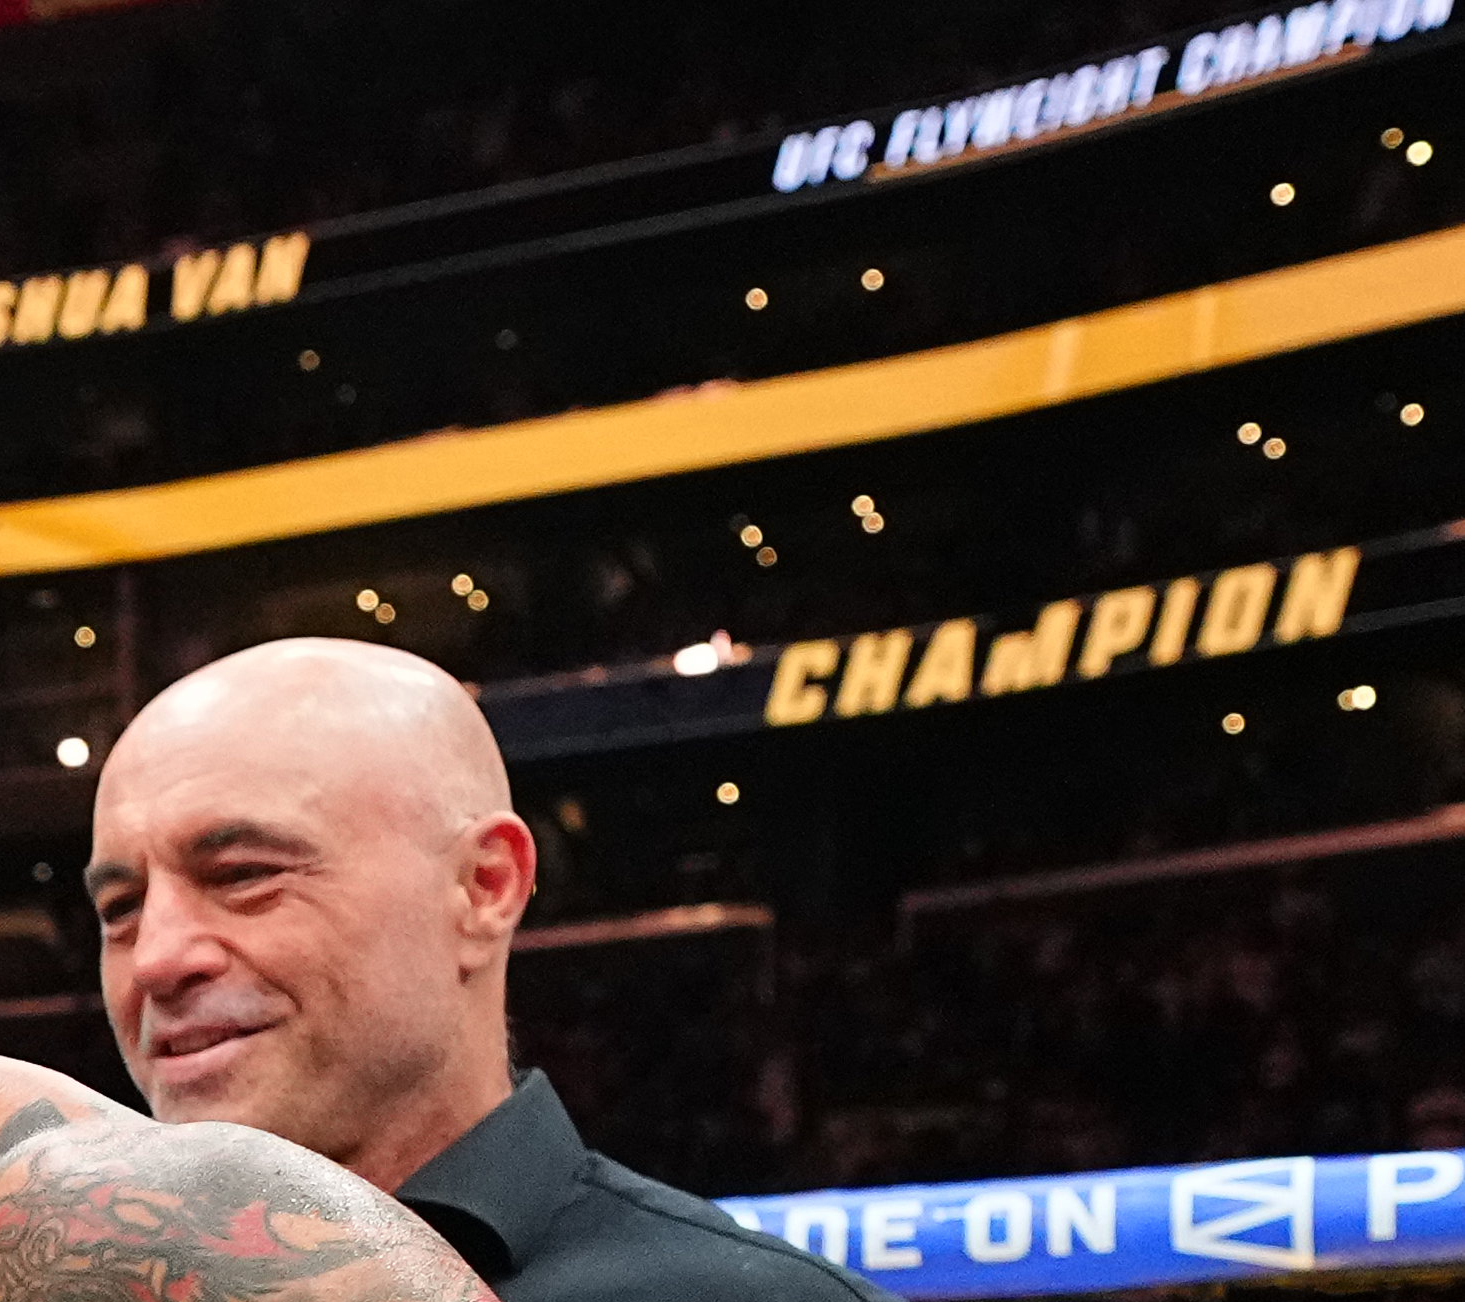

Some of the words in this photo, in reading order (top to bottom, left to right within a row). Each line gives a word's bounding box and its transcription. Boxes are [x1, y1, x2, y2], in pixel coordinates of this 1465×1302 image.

[771, 120, 875, 193] UFC
[170, 232, 311, 322] VAN
[764, 547, 1360, 727] CHAMPION
[964, 1184, 1118, 1264] ON
